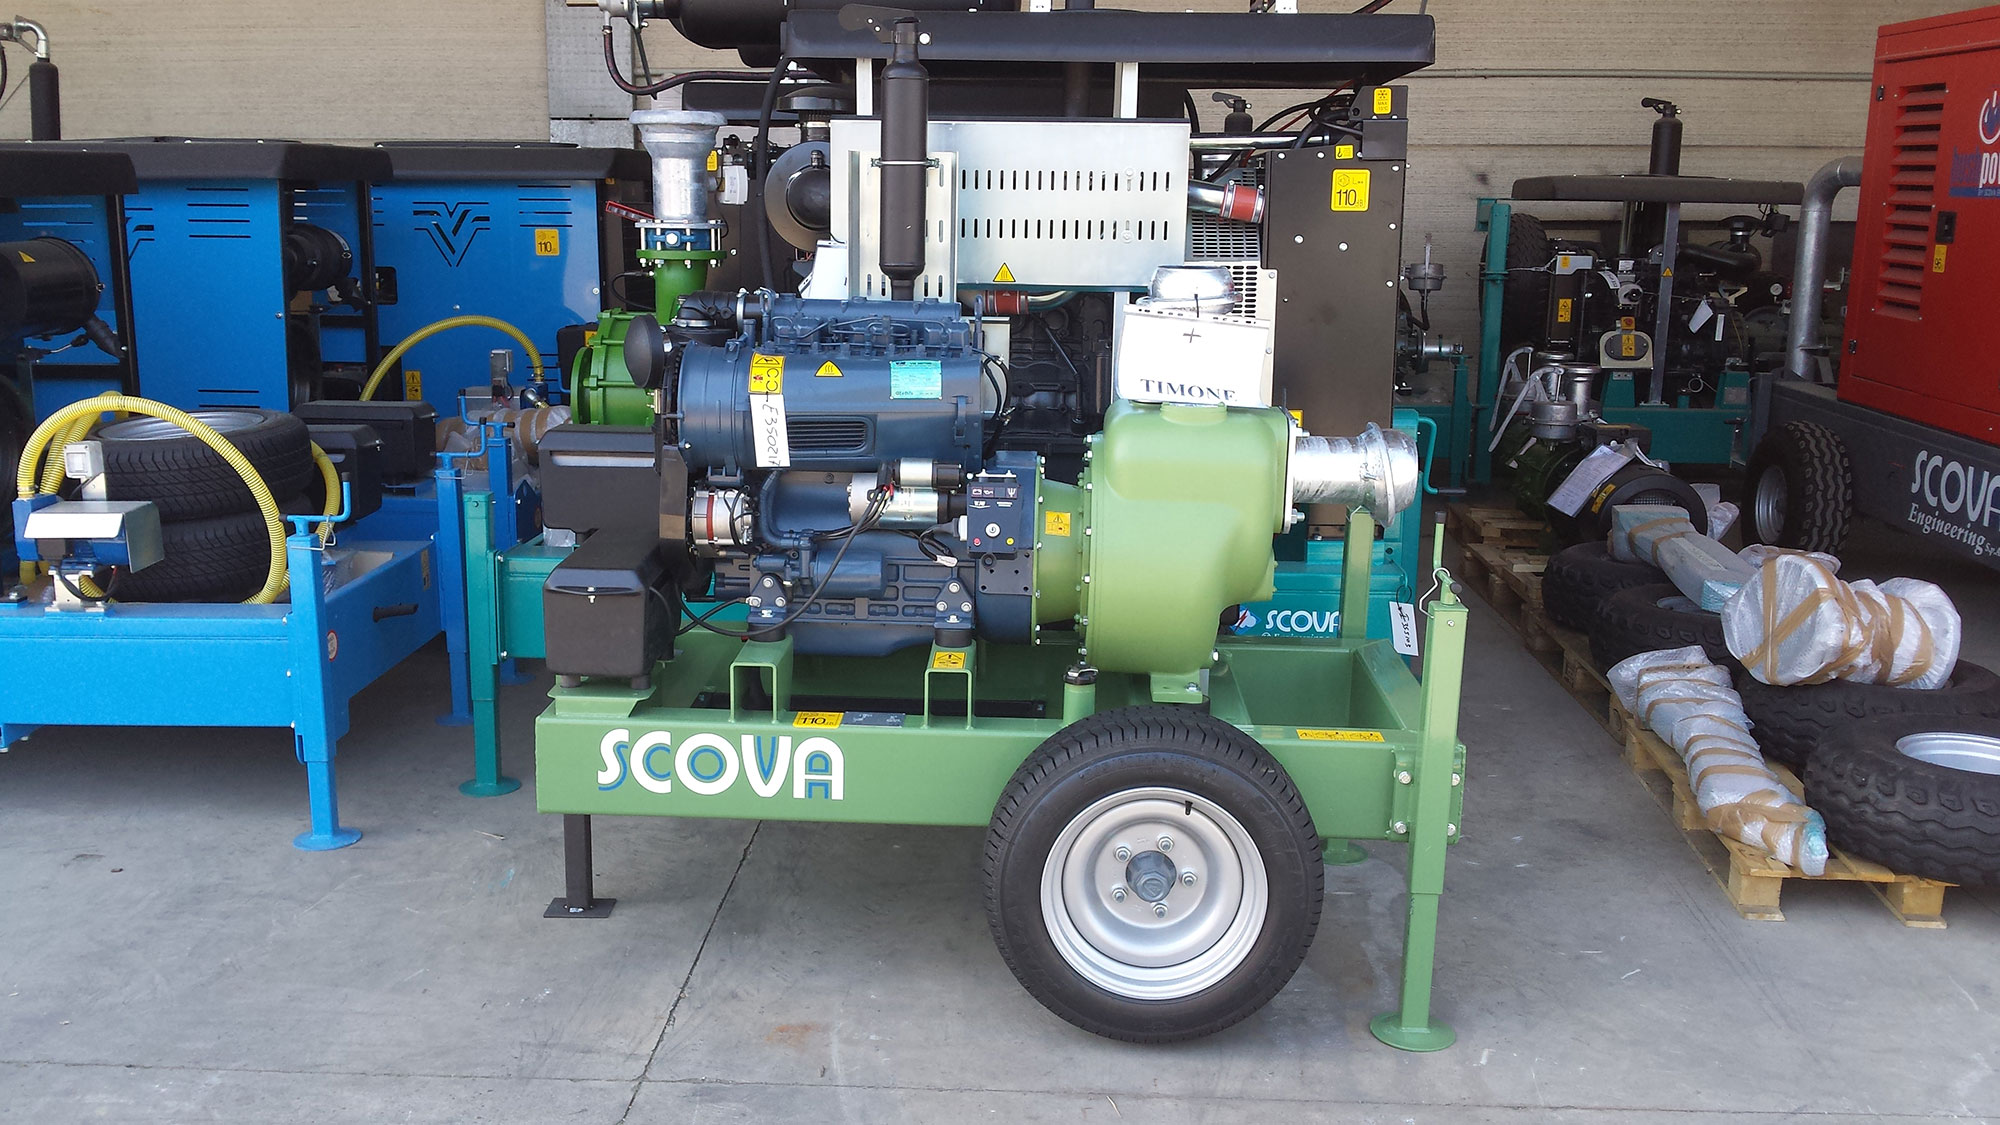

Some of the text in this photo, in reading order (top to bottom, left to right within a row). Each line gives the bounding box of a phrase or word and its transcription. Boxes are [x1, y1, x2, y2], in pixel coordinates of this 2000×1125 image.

[1336, 189, 1357, 206] 110
[537, 241, 552, 253] 110
[1140, 378, 1237, 401] TIMONE
[1908, 502, 1986, 555] Engineering
[801, 717, 826, 725] 110
[597, 728, 845, 800] SCOVA
